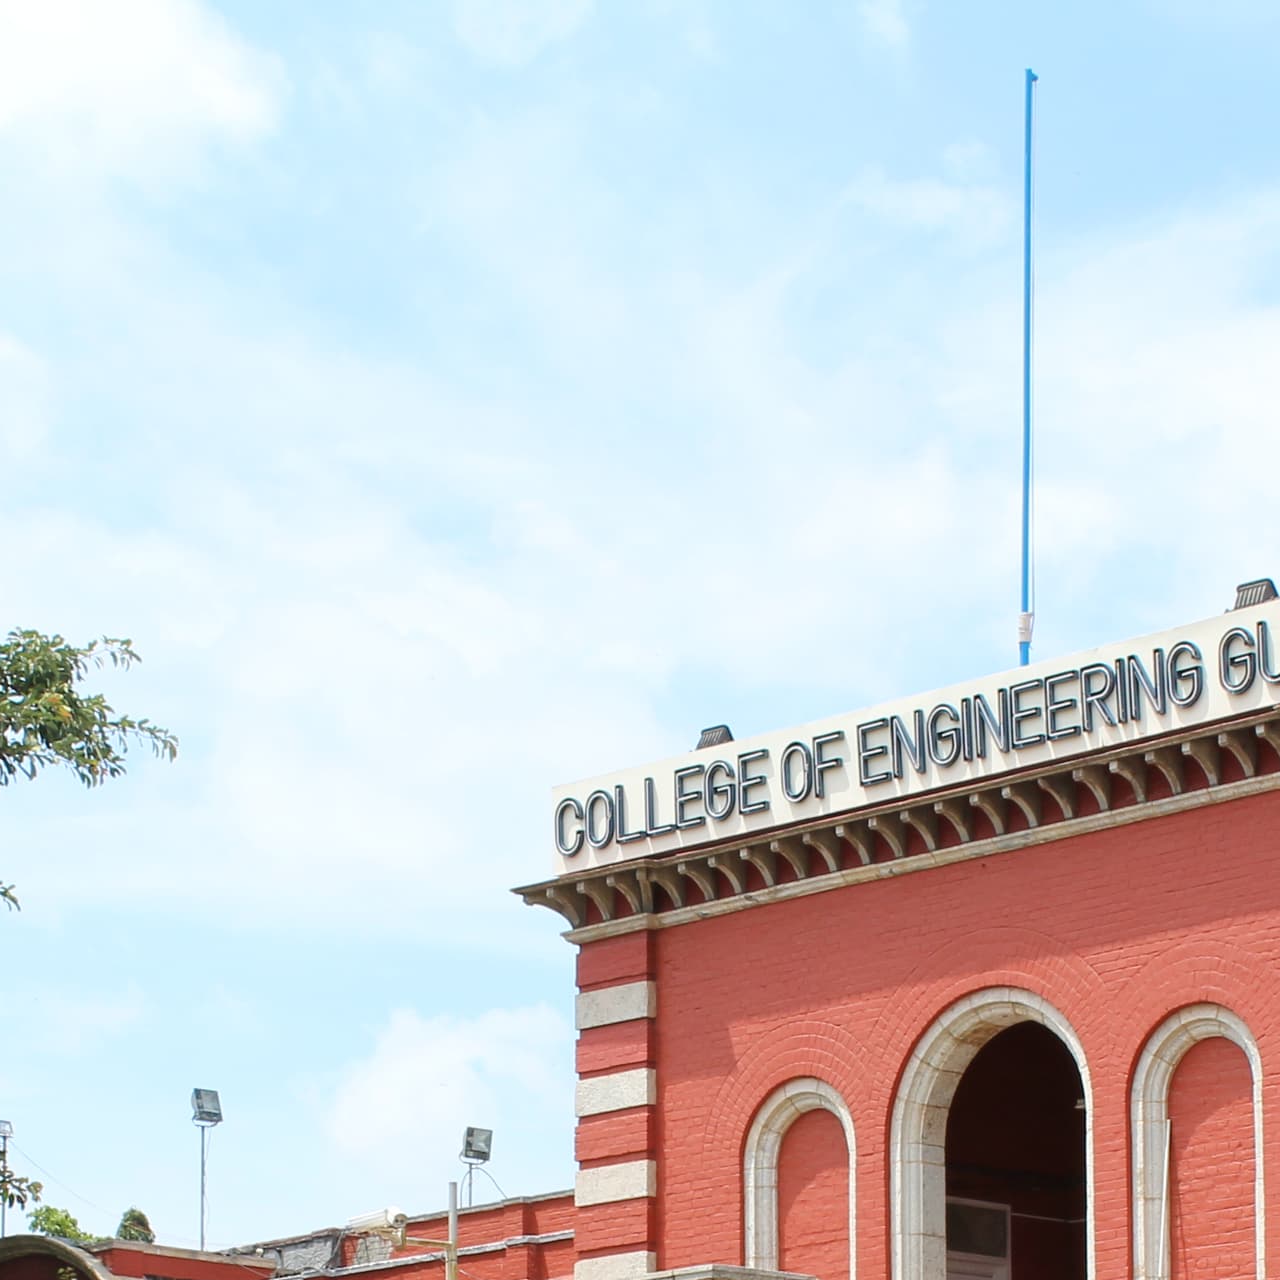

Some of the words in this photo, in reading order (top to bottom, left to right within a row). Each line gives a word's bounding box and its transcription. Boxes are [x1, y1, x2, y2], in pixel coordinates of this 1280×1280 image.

[554, 748, 769, 857] COLLEGE
[780, 730, 844, 803] OF
[856, 641, 1204, 786] ENGINEERING
